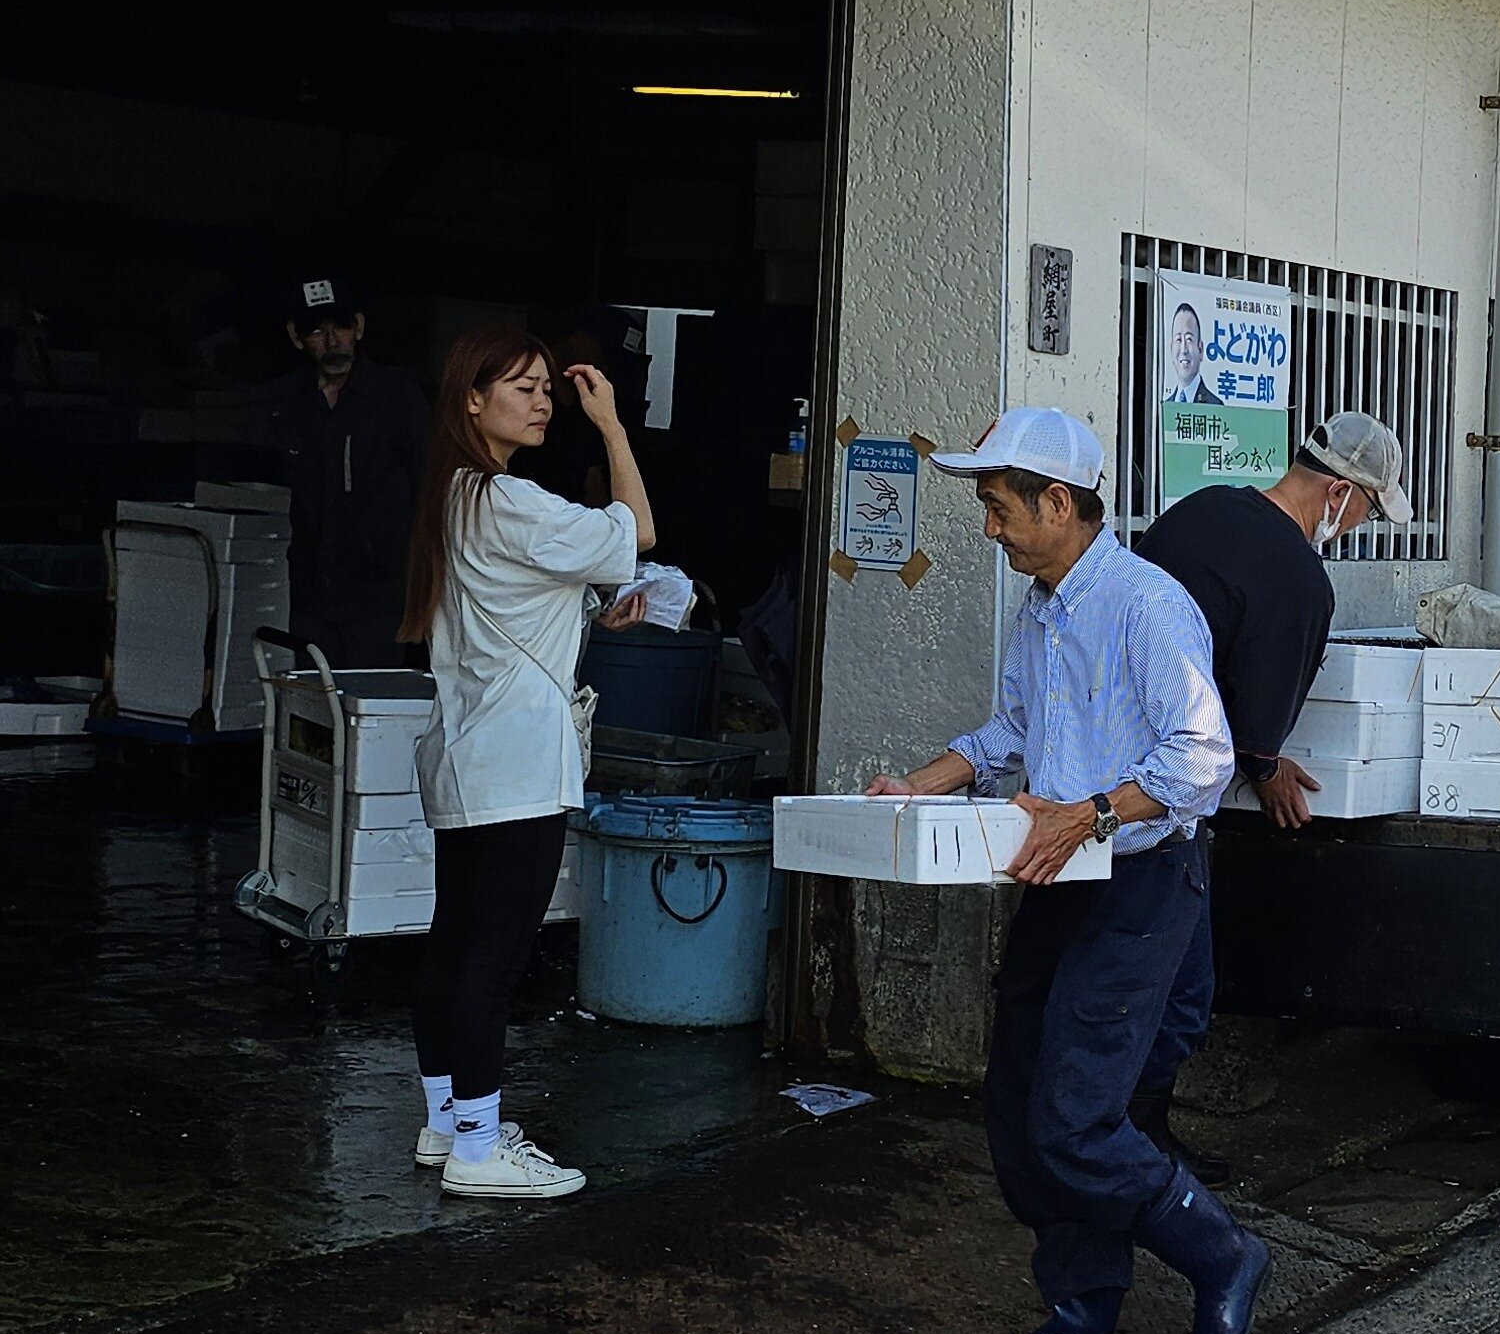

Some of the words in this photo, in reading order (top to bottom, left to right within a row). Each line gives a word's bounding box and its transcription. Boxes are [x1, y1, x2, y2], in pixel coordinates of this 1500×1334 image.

[1206, 320, 1287, 368] よどがわ
[1217, 370, 1275, 404] 幸二郎
[1175, 412, 1230, 442] 福岡市と
[852, 445, 914, 459] アルコール消毒に
[1207, 445, 1276, 472] 国をつなぐ
[1432, 722, 1462, 761] 37
[1425, 784, 1460, 813] 88
